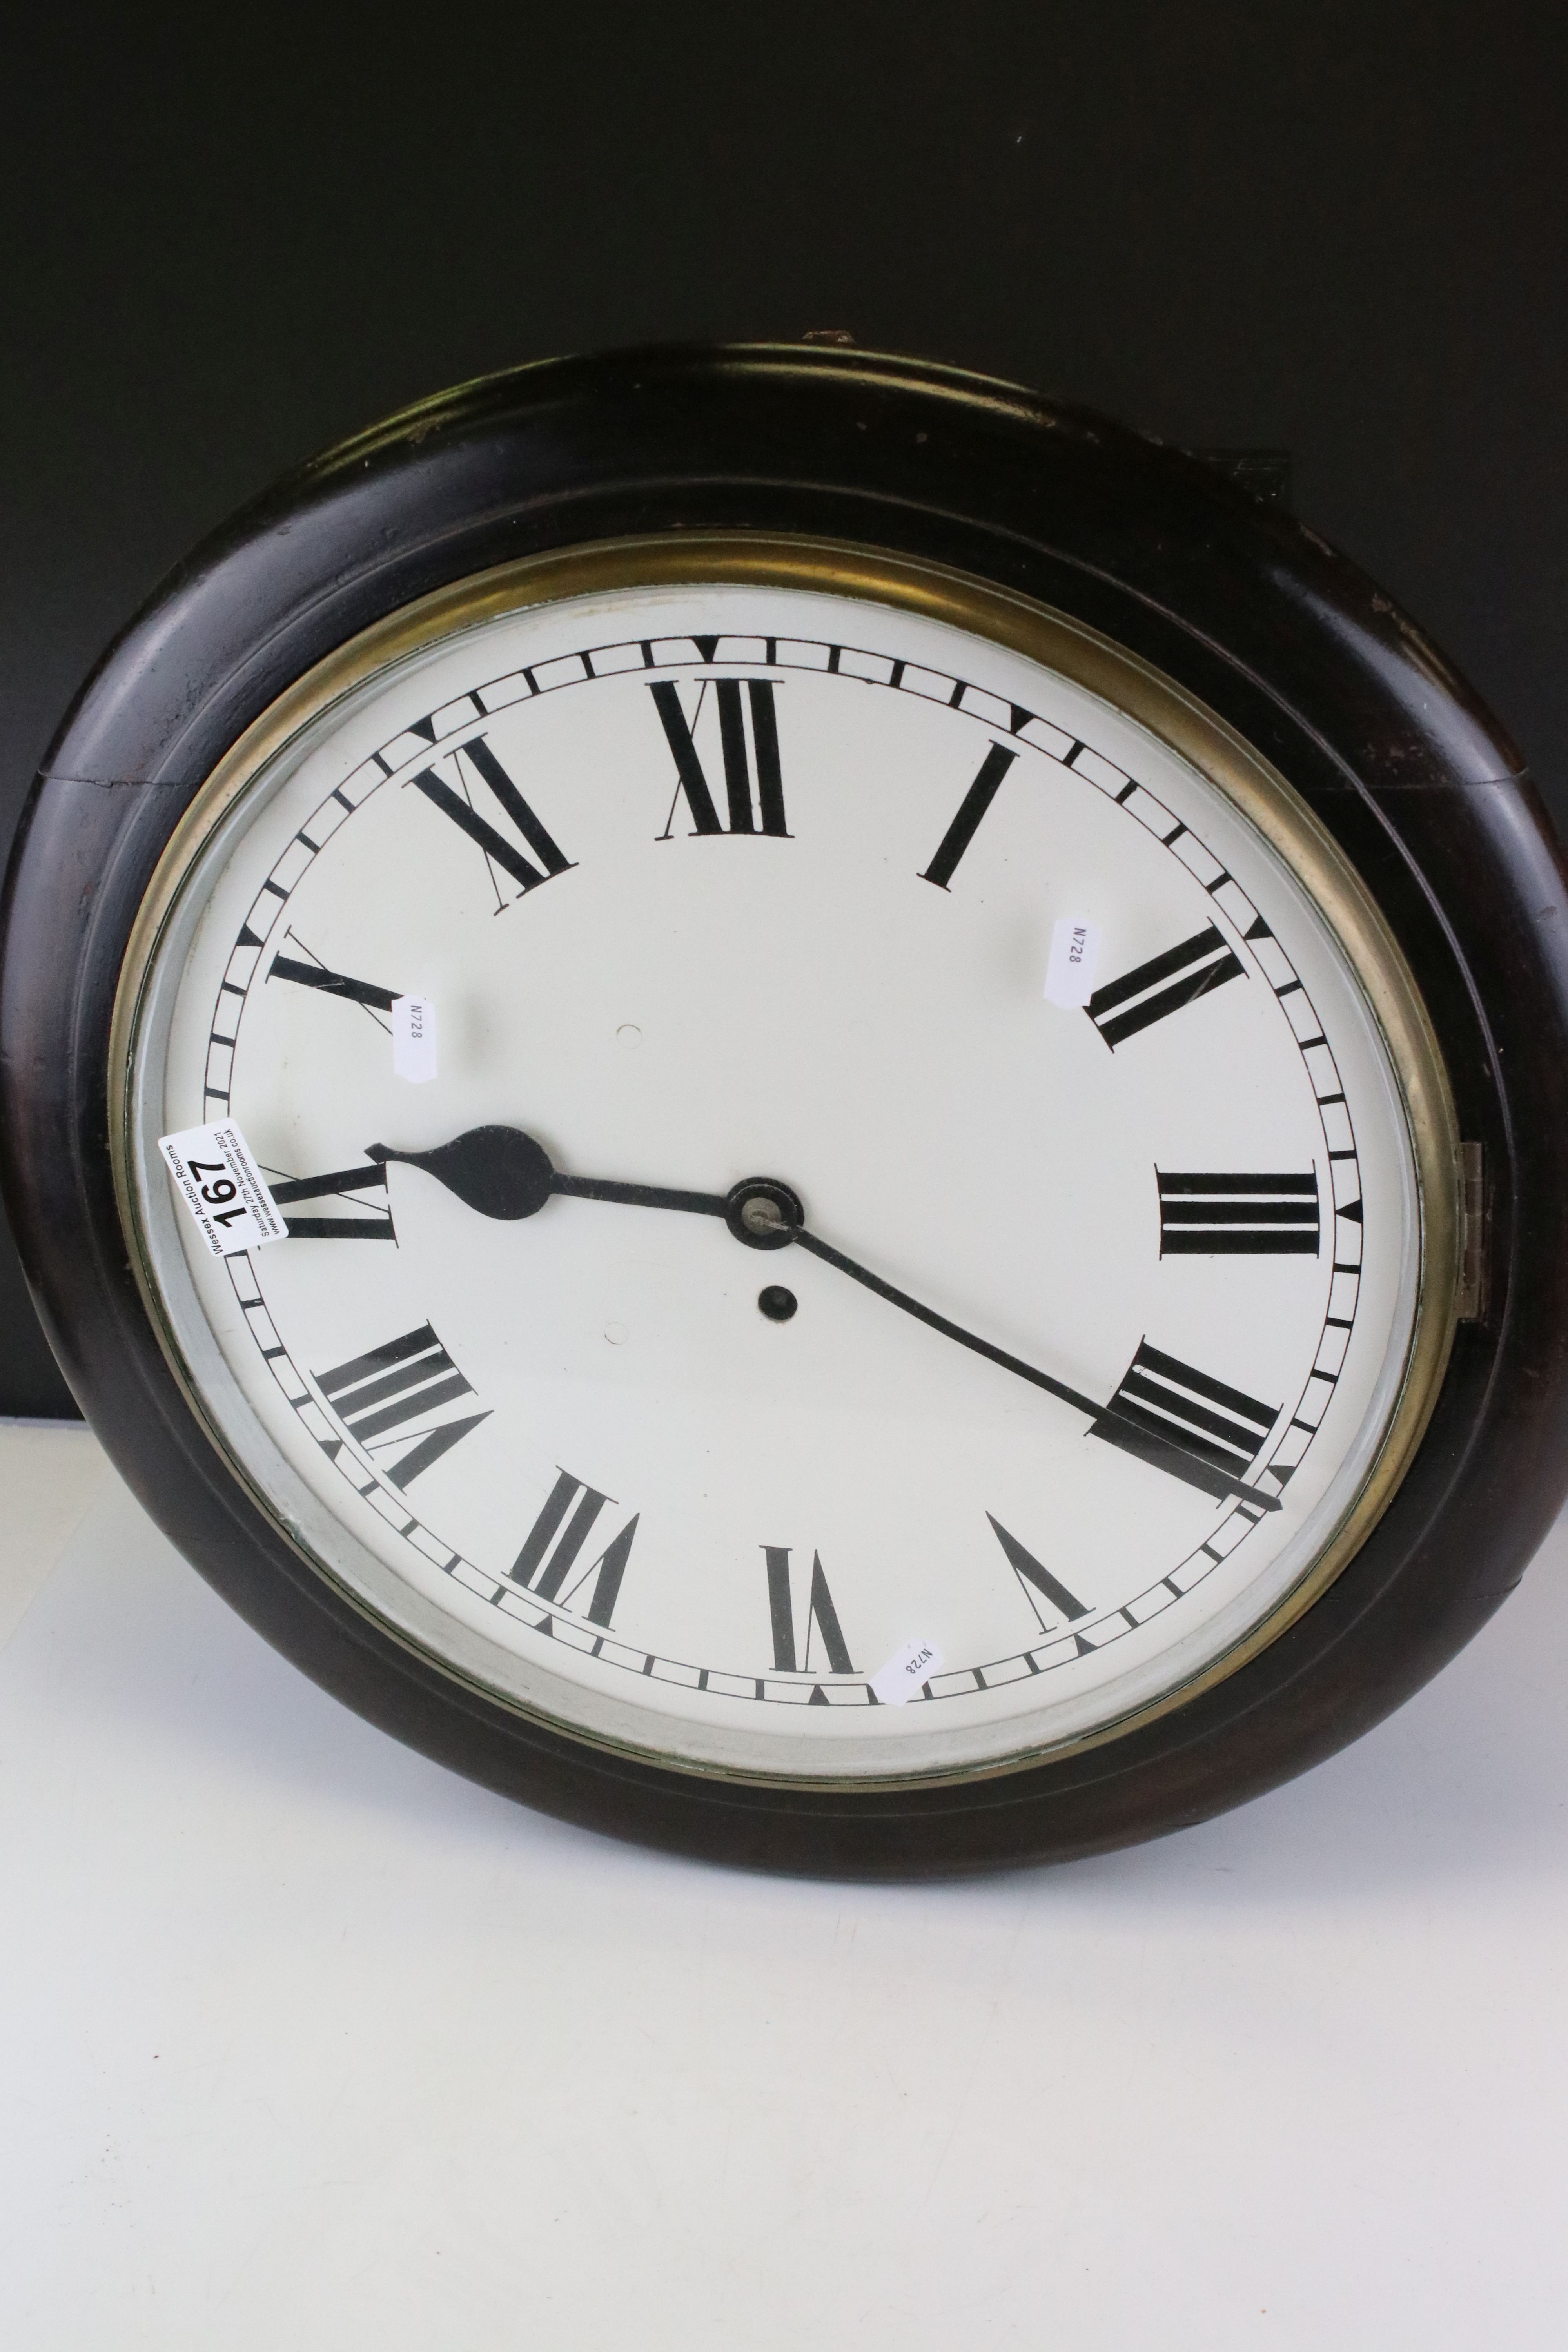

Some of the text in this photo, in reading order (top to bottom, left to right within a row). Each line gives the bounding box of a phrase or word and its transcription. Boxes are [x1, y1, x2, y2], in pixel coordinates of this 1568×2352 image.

[644, 677, 795, 841] XII
[401, 732, 579, 916] XI
[916, 739, 1020, 893] I
[265, 925, 405, 1036] X
[1069, 927, 1087, 963] N728
[1082, 916, 1250, 1054] II
[410, 1005, 423, 1038] N728
[166, 1145, 223, 1255] Wessex Auction Rooms
[187, 1160, 247, 1228] 167
[214, 1132, 269, 1237] Saturday 27th November 2021
[224, 1129, 280, 1235] www.wessexauctionrooms.co.uk
[1154, 1159, 1320, 1261] III
[310, 1319, 494, 1497] VIII
[501, 1465, 640, 1632] VII
[985, 1511, 1096, 1635] V
[759, 1545, 864, 1674] VI
[906, 1648, 933, 1674] N728
